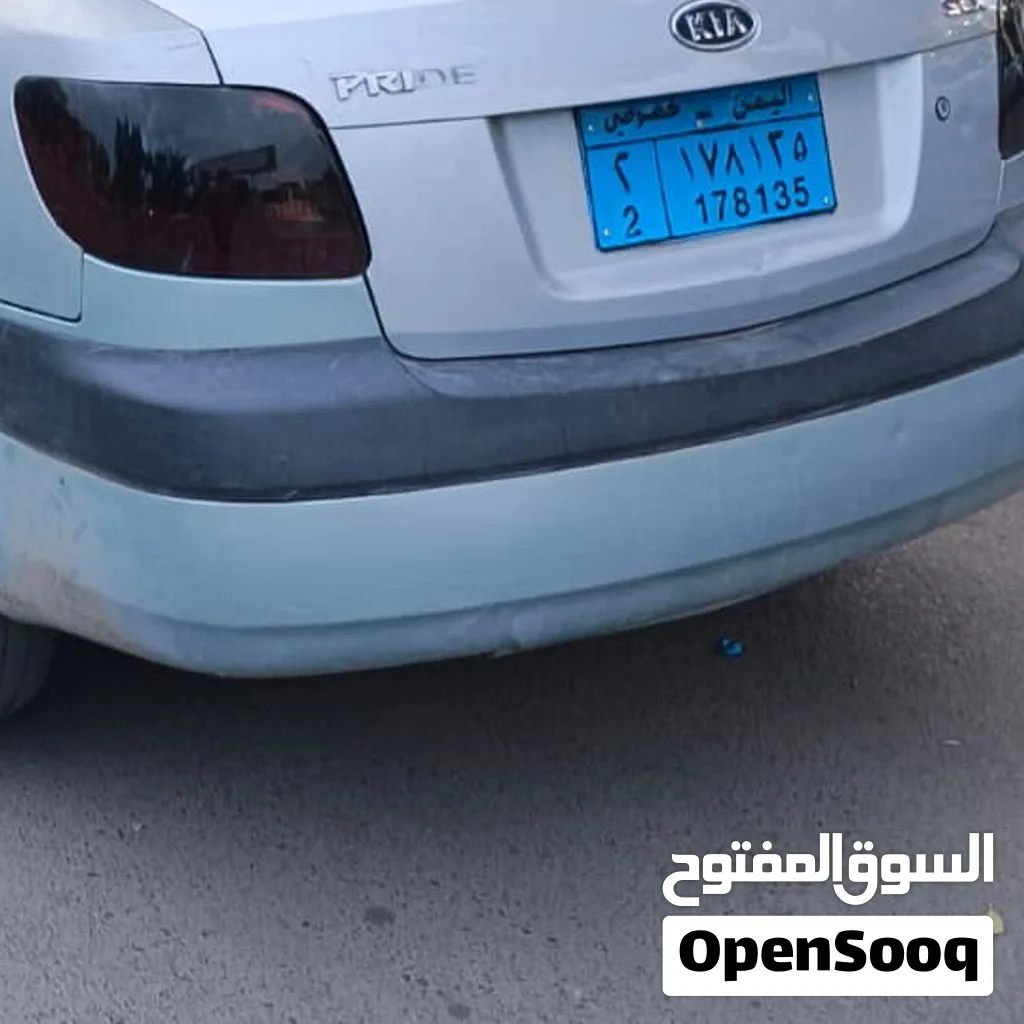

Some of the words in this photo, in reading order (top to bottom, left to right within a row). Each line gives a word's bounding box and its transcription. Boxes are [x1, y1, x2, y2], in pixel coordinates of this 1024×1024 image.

[685, 7, 748, 42] KIA
[328, 63, 478, 103] PRIDE
[694, 175, 811, 225] 178135
[622, 204, 643, 238] 2
